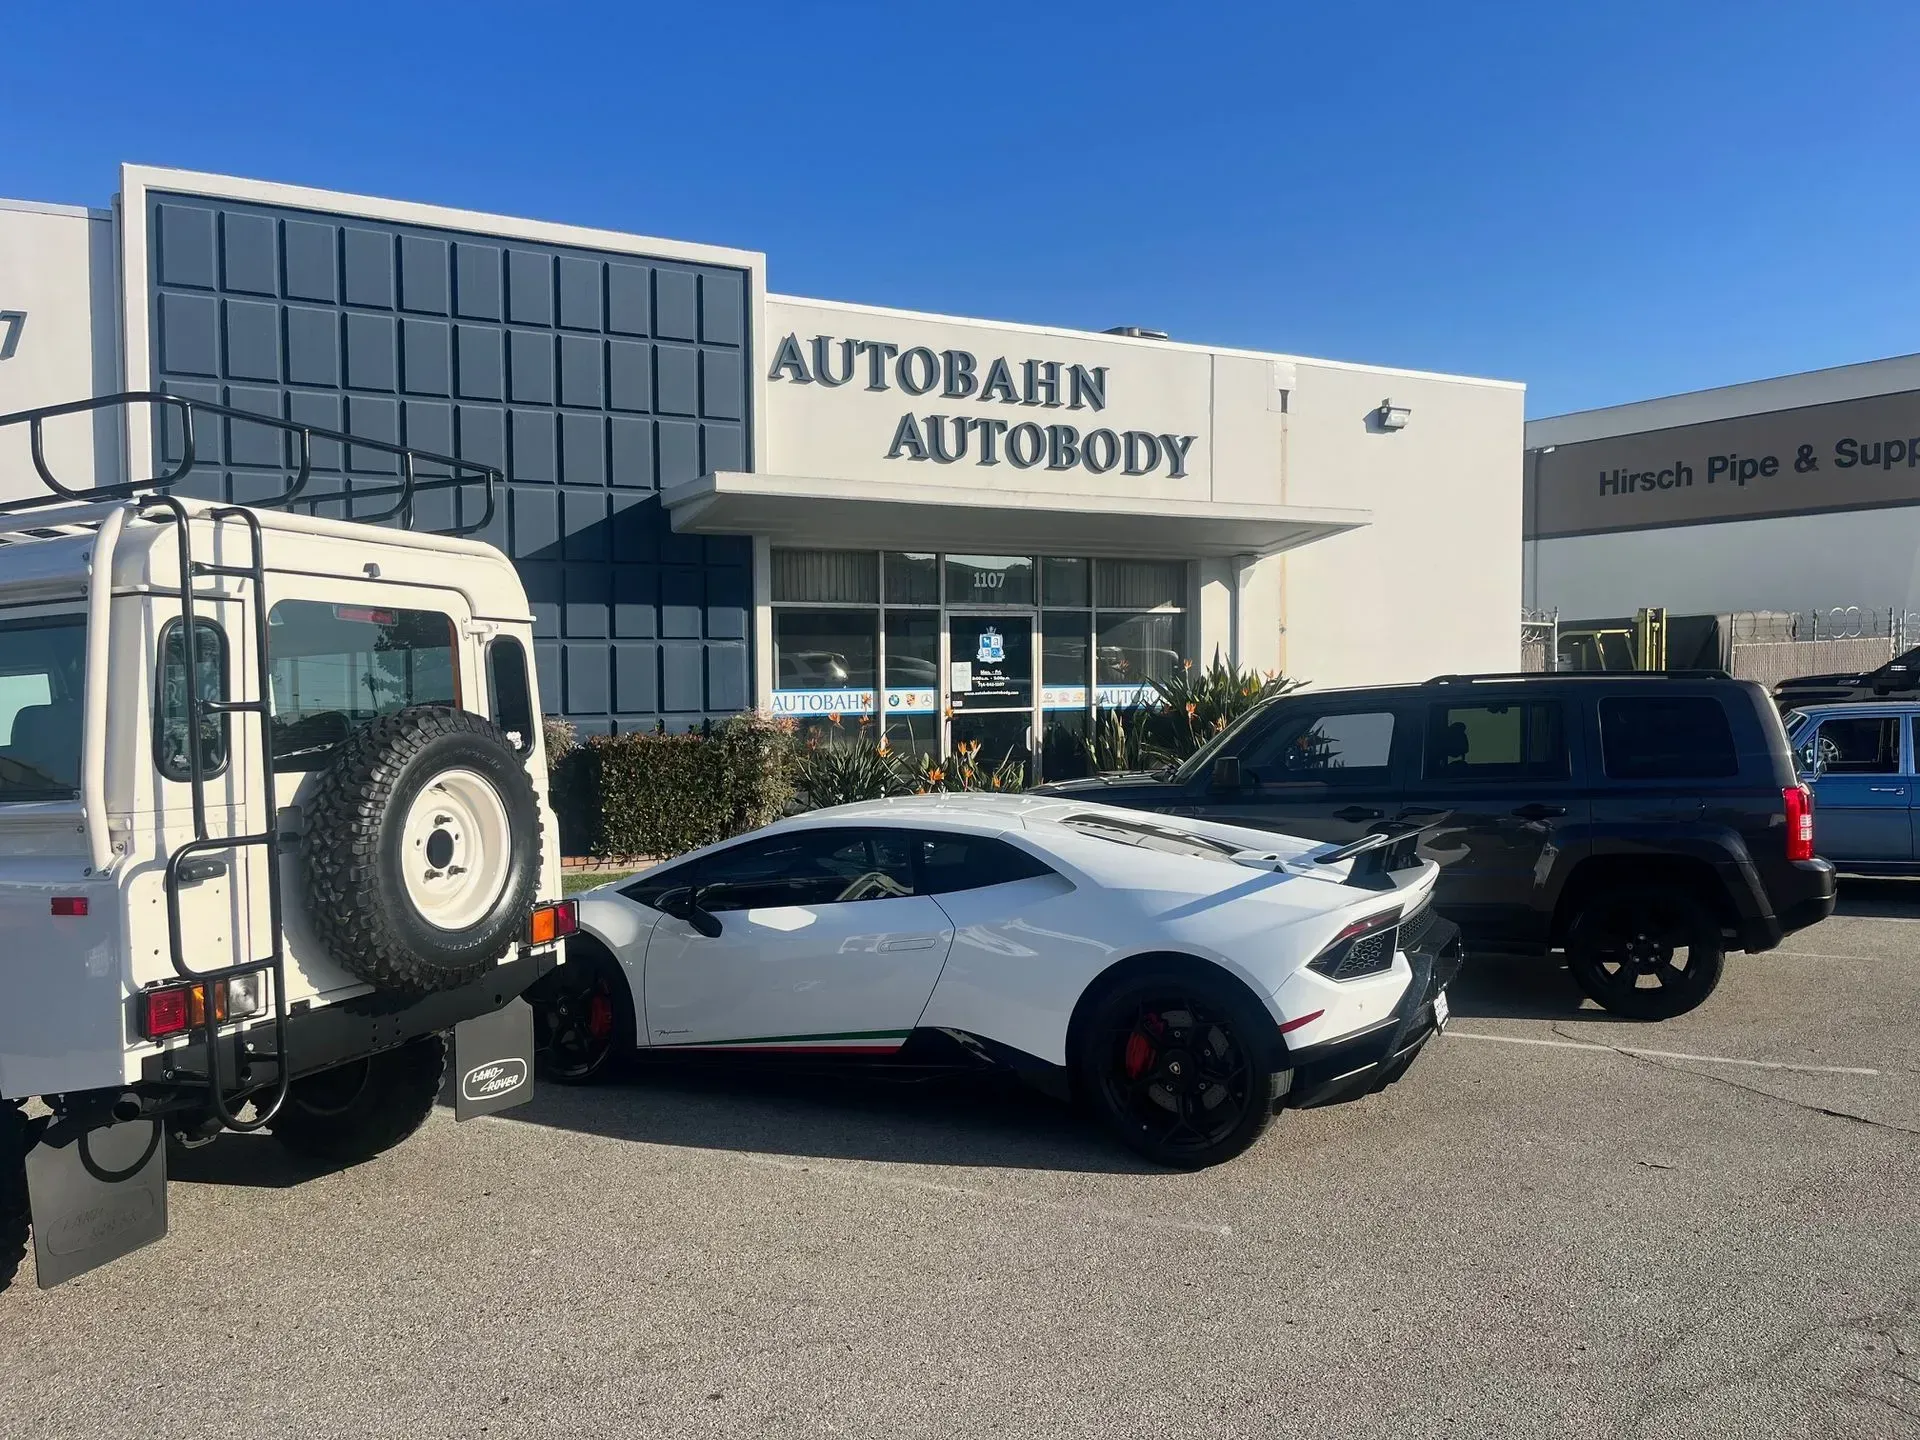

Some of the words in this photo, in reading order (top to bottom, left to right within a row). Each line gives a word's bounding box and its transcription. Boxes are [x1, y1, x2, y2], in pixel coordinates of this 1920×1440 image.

[768, 331, 1110, 412] AUTOBAHN
[883, 411, 1198, 479] AUTOBODY
[1600, 461, 1693, 496] Hirsch
[1708, 454, 1779, 487] Pipe
[1794, 444, 1820, 473] &
[974, 572, 1005, 588] 1107
[472, 1067, 499, 1083] LAND
[486, 1075, 518, 1092] ROVER
